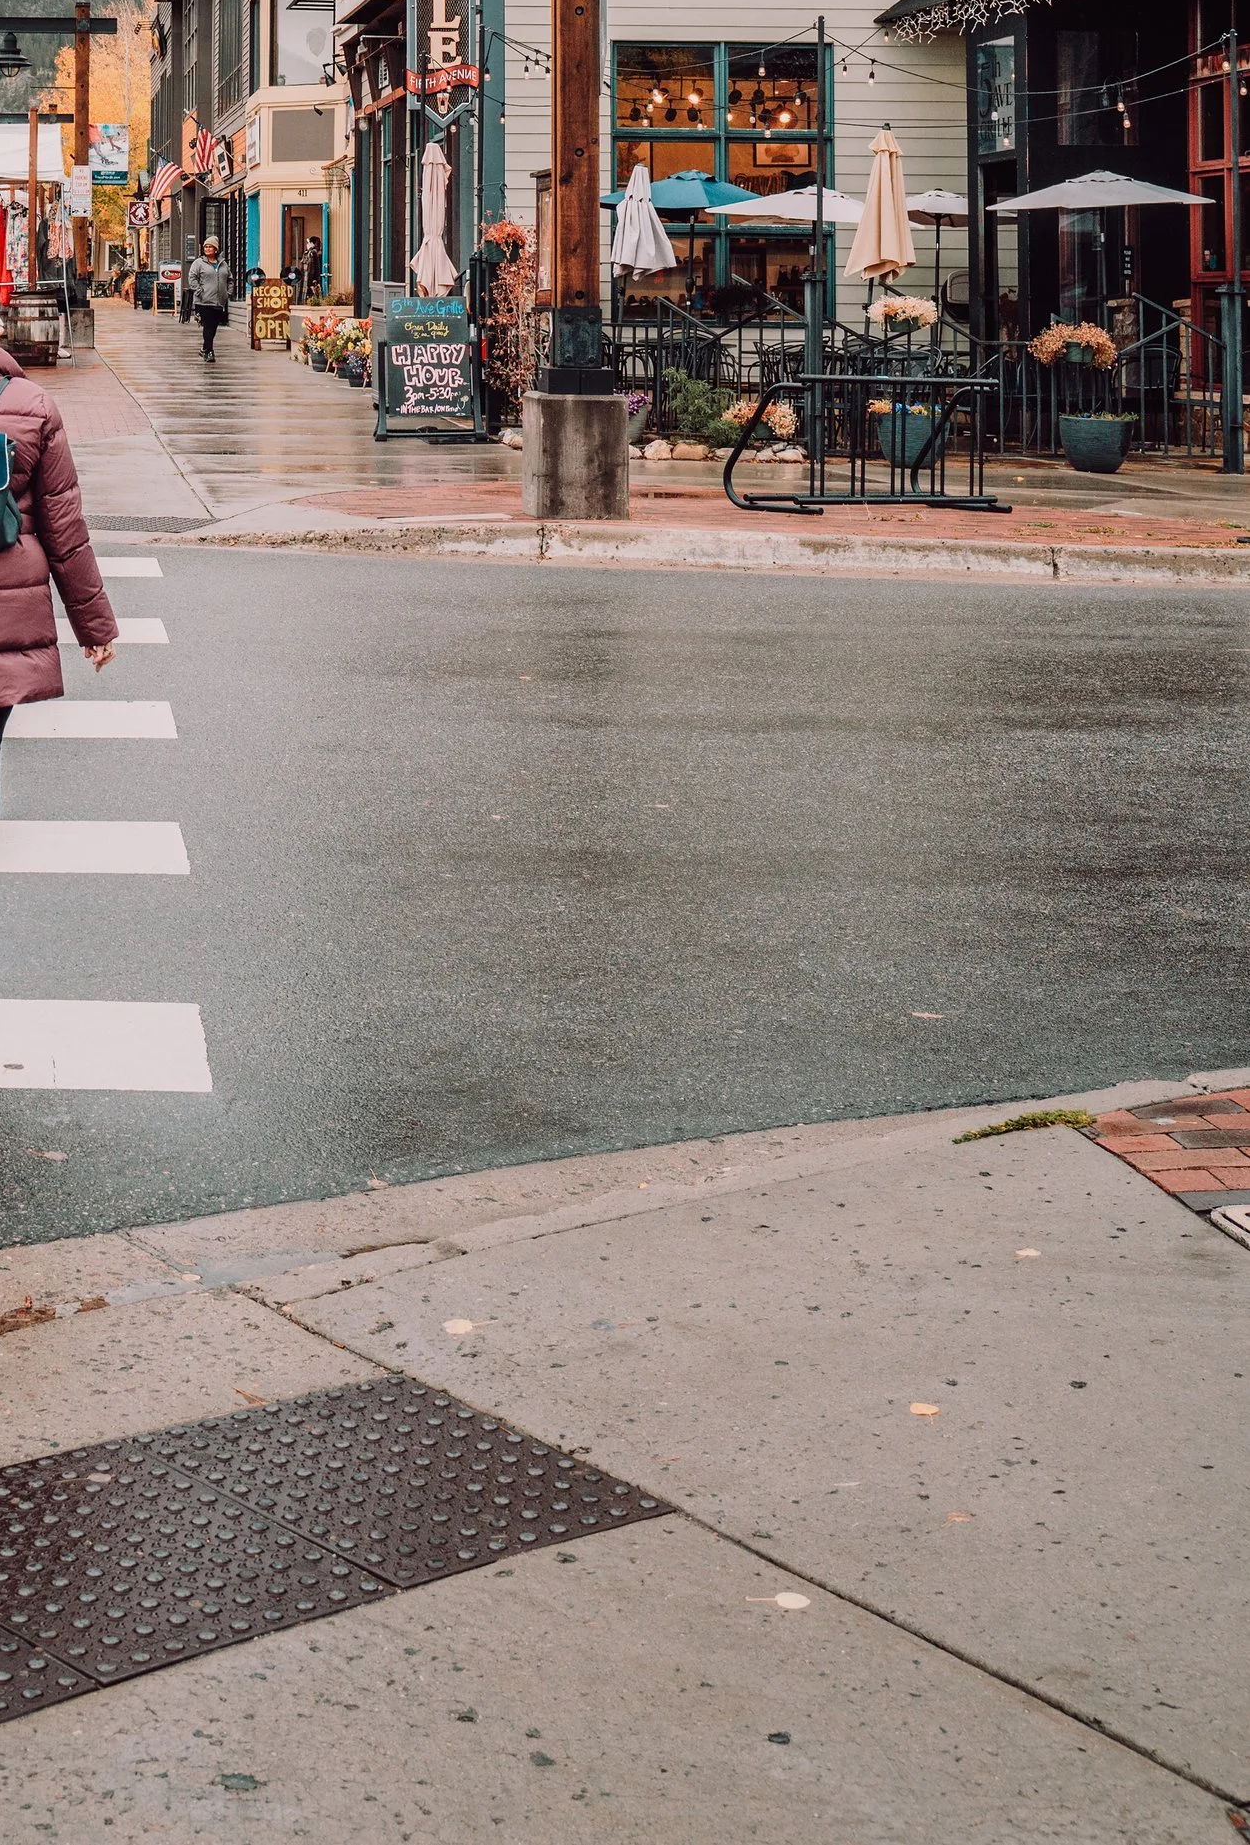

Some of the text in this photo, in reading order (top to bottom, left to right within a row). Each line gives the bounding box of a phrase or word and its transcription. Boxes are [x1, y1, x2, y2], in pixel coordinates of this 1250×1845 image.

[438, 68, 477, 85] AVENUE
[298, 189, 308, 197] 411
[253, 285, 294, 298] RECORD
[257, 297, 288, 309] SHOP
[392, 299, 465, 316] 5th Ave Grille
[255, 319, 290, 339] OPEN
[404, 321, 449, 335] Open Daily
[391, 343, 466, 365] HAPPY
[403, 364, 464, 387] HOUR
